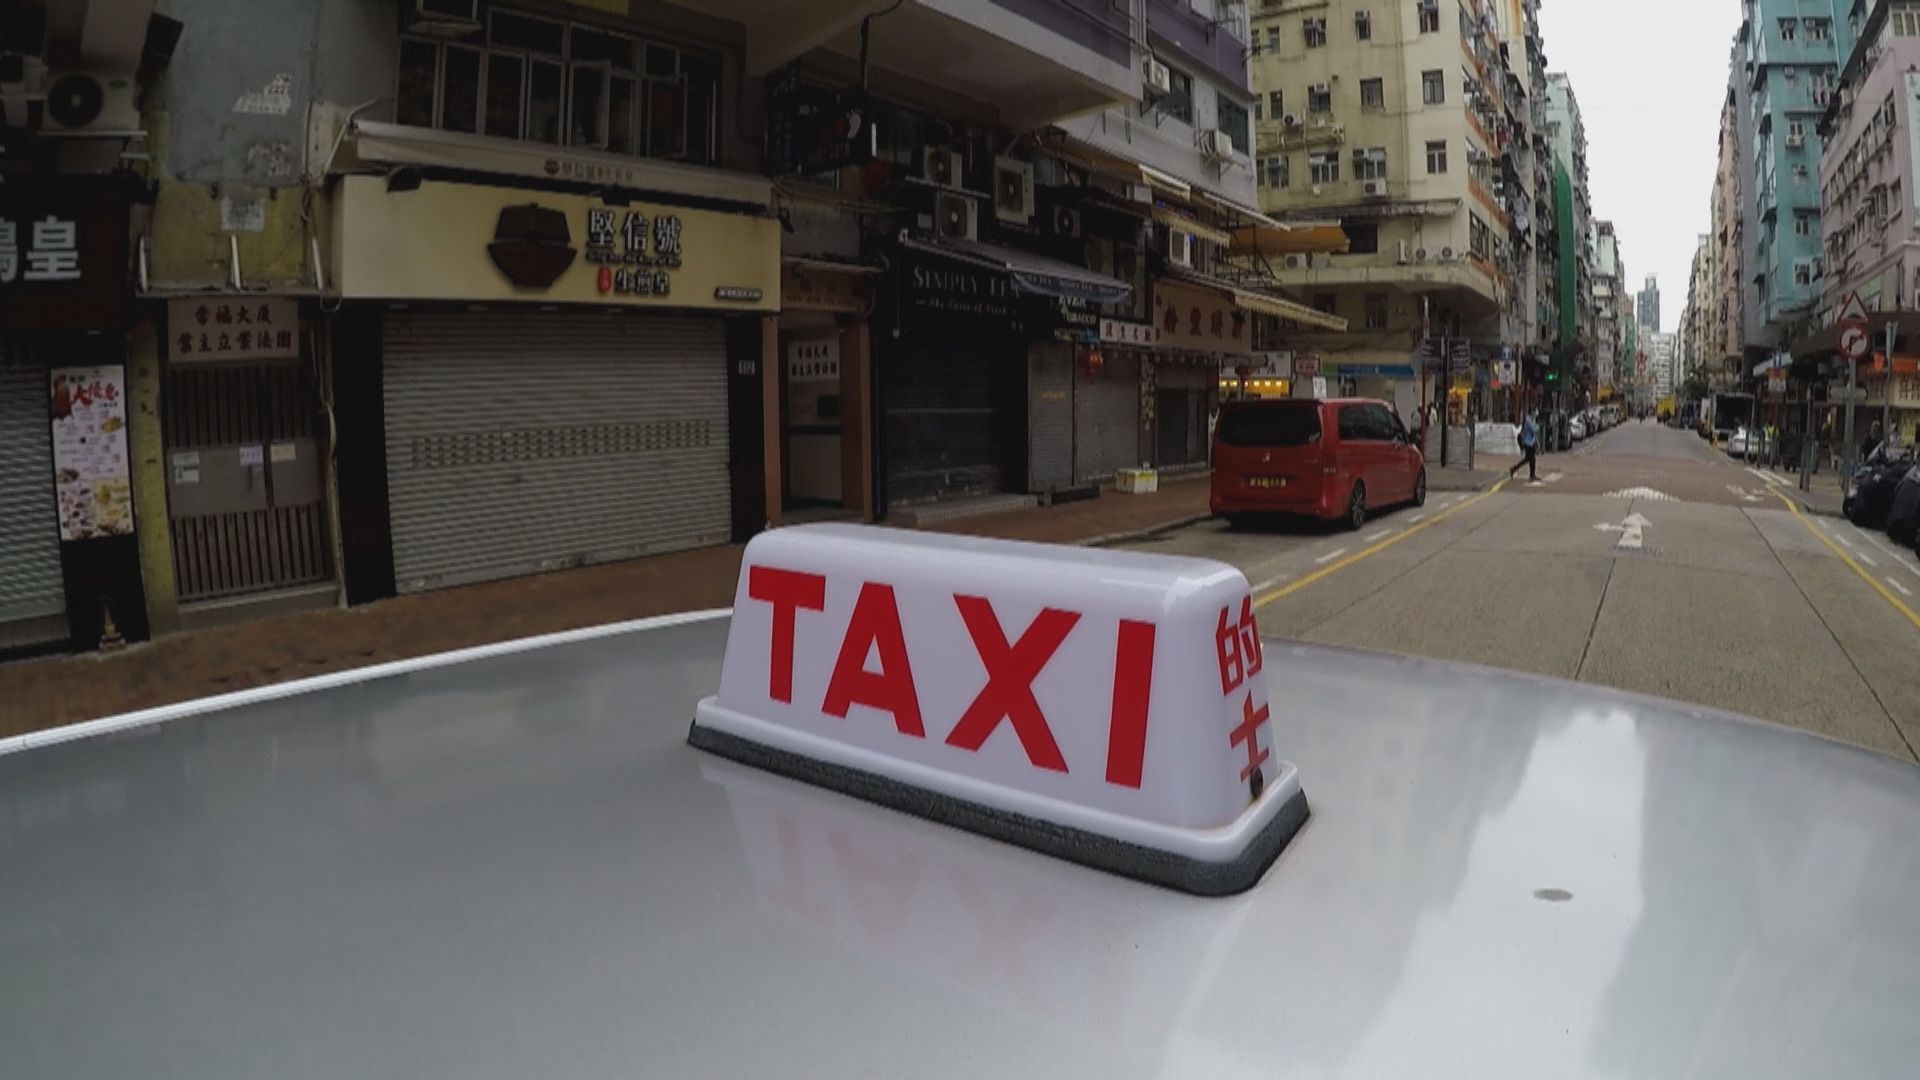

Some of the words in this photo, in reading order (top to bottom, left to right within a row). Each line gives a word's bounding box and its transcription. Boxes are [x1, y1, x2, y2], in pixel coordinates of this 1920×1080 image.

[589, 209, 682, 254] 堅信號
[748, 566, 1156, 788] TAXI
[1215, 596, 1269, 782] 的士
